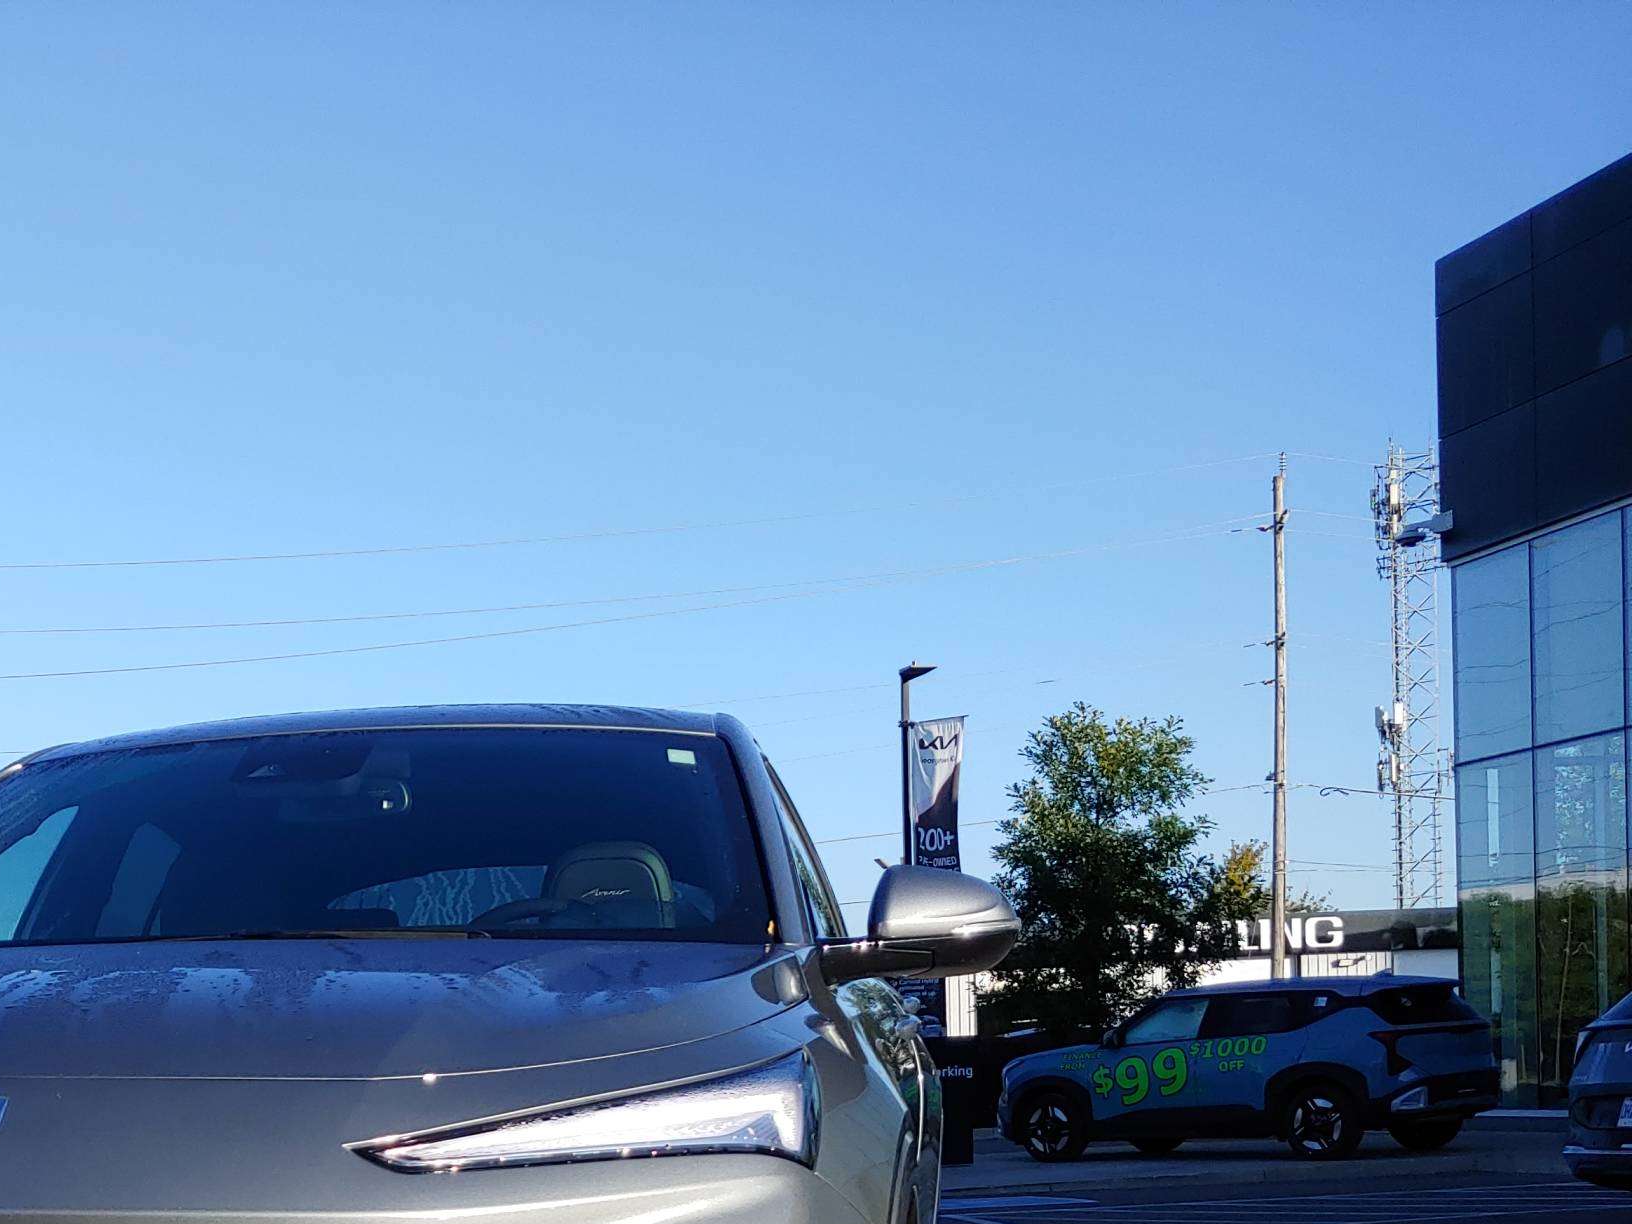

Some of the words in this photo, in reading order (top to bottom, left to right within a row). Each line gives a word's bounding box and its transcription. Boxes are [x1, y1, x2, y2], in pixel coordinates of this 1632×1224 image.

[1189, 1035, 1268, 1059] $1000
[1092, 1047, 1188, 1106] $99
[1218, 1059, 1245, 1073] OFF
